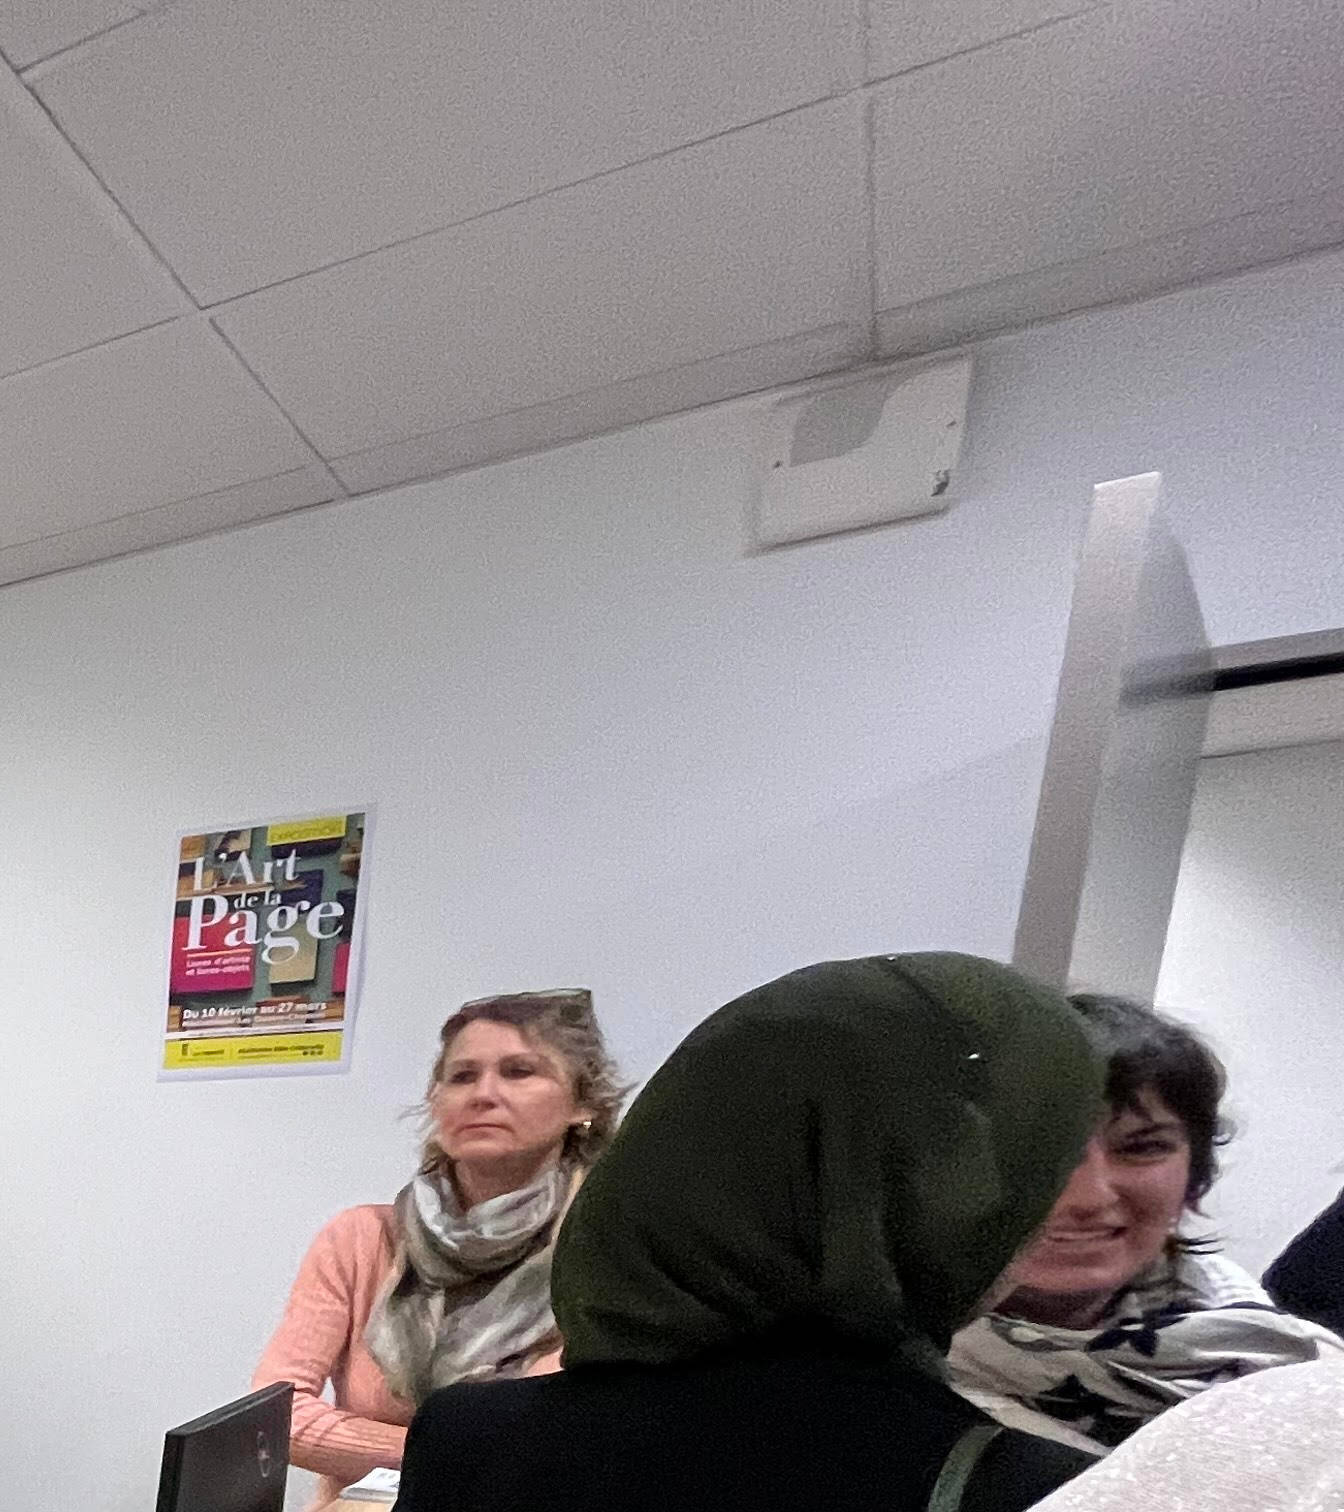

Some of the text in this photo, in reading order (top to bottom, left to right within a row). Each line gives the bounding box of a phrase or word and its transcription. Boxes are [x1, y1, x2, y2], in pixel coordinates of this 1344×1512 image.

[193, 849, 302, 892] L'Art
[234, 888, 283, 909] de la
[182, 894, 346, 965] Page
[182, 1008, 199, 1020] Du
[277, 1001, 294, 1014] 27
